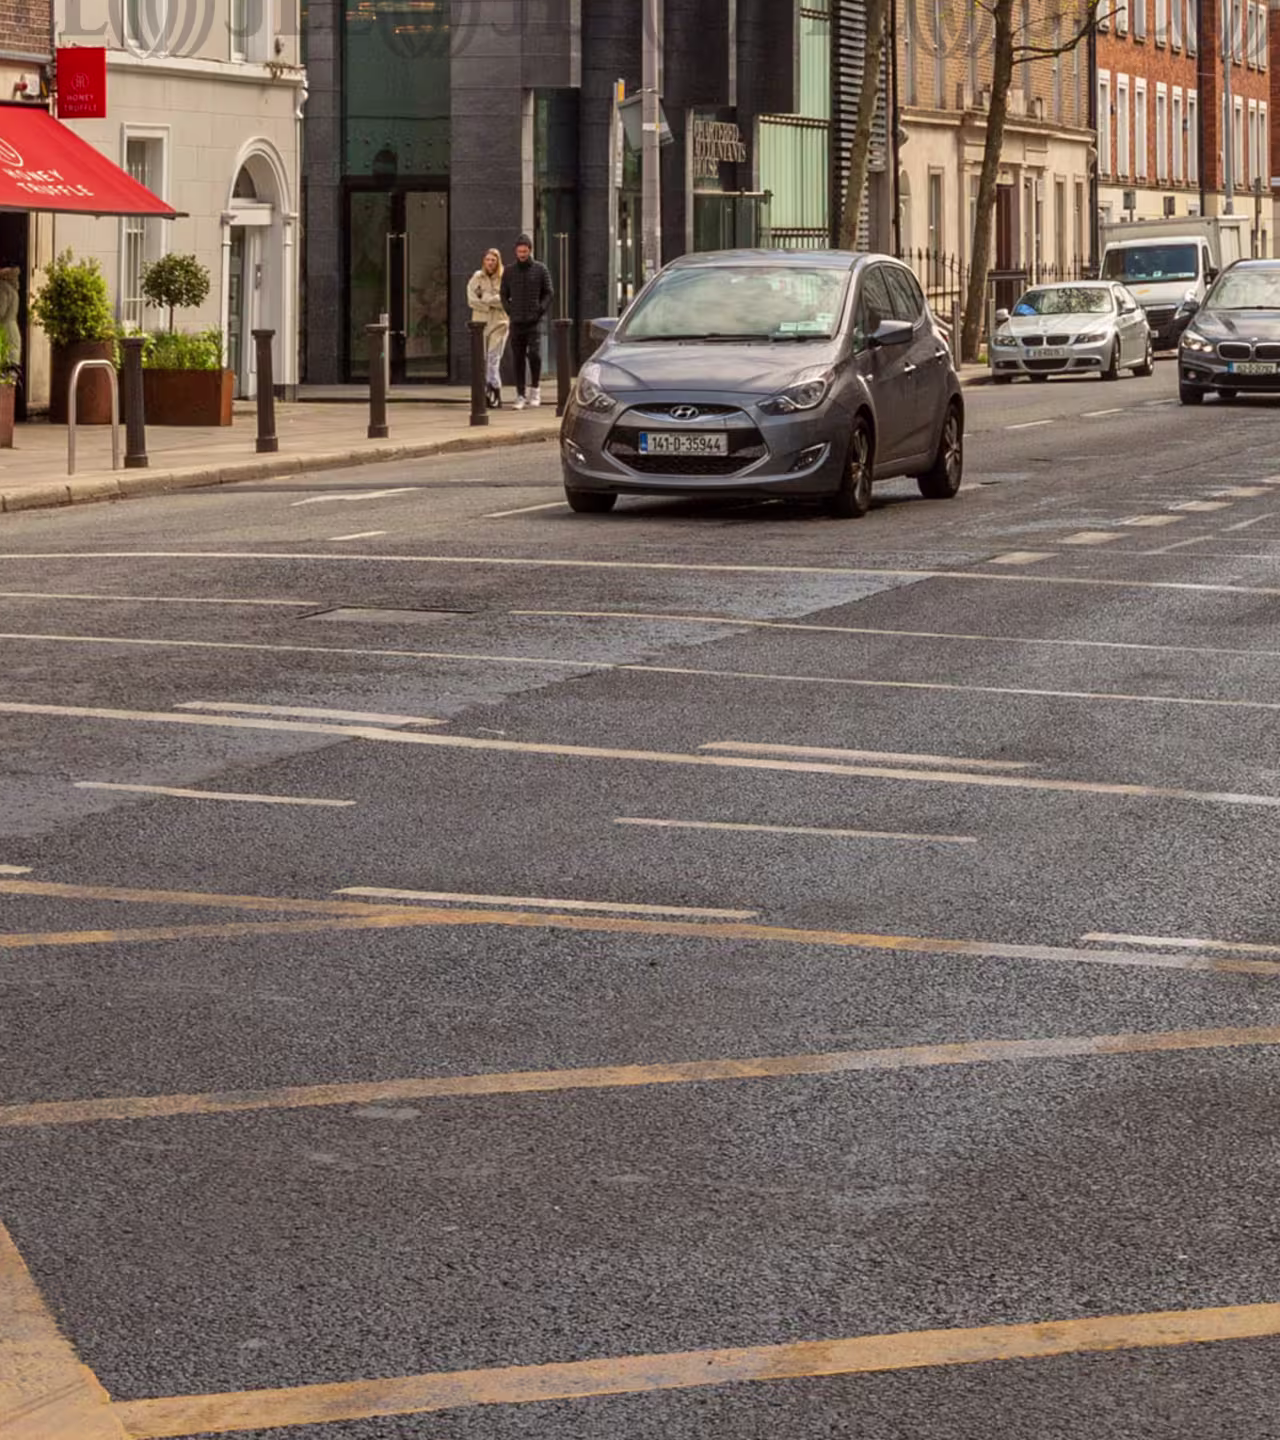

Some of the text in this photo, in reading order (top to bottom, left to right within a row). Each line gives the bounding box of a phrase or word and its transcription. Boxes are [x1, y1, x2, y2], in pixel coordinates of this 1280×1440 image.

[66, 94, 95, 102] HONEY
[63, 103, 98, 112] TRUFFLE
[2, 168, 65, 182] HONEY
[693, 158, 719, 179] HOUSE
[16, 181, 96, 197] TRUFFLE
